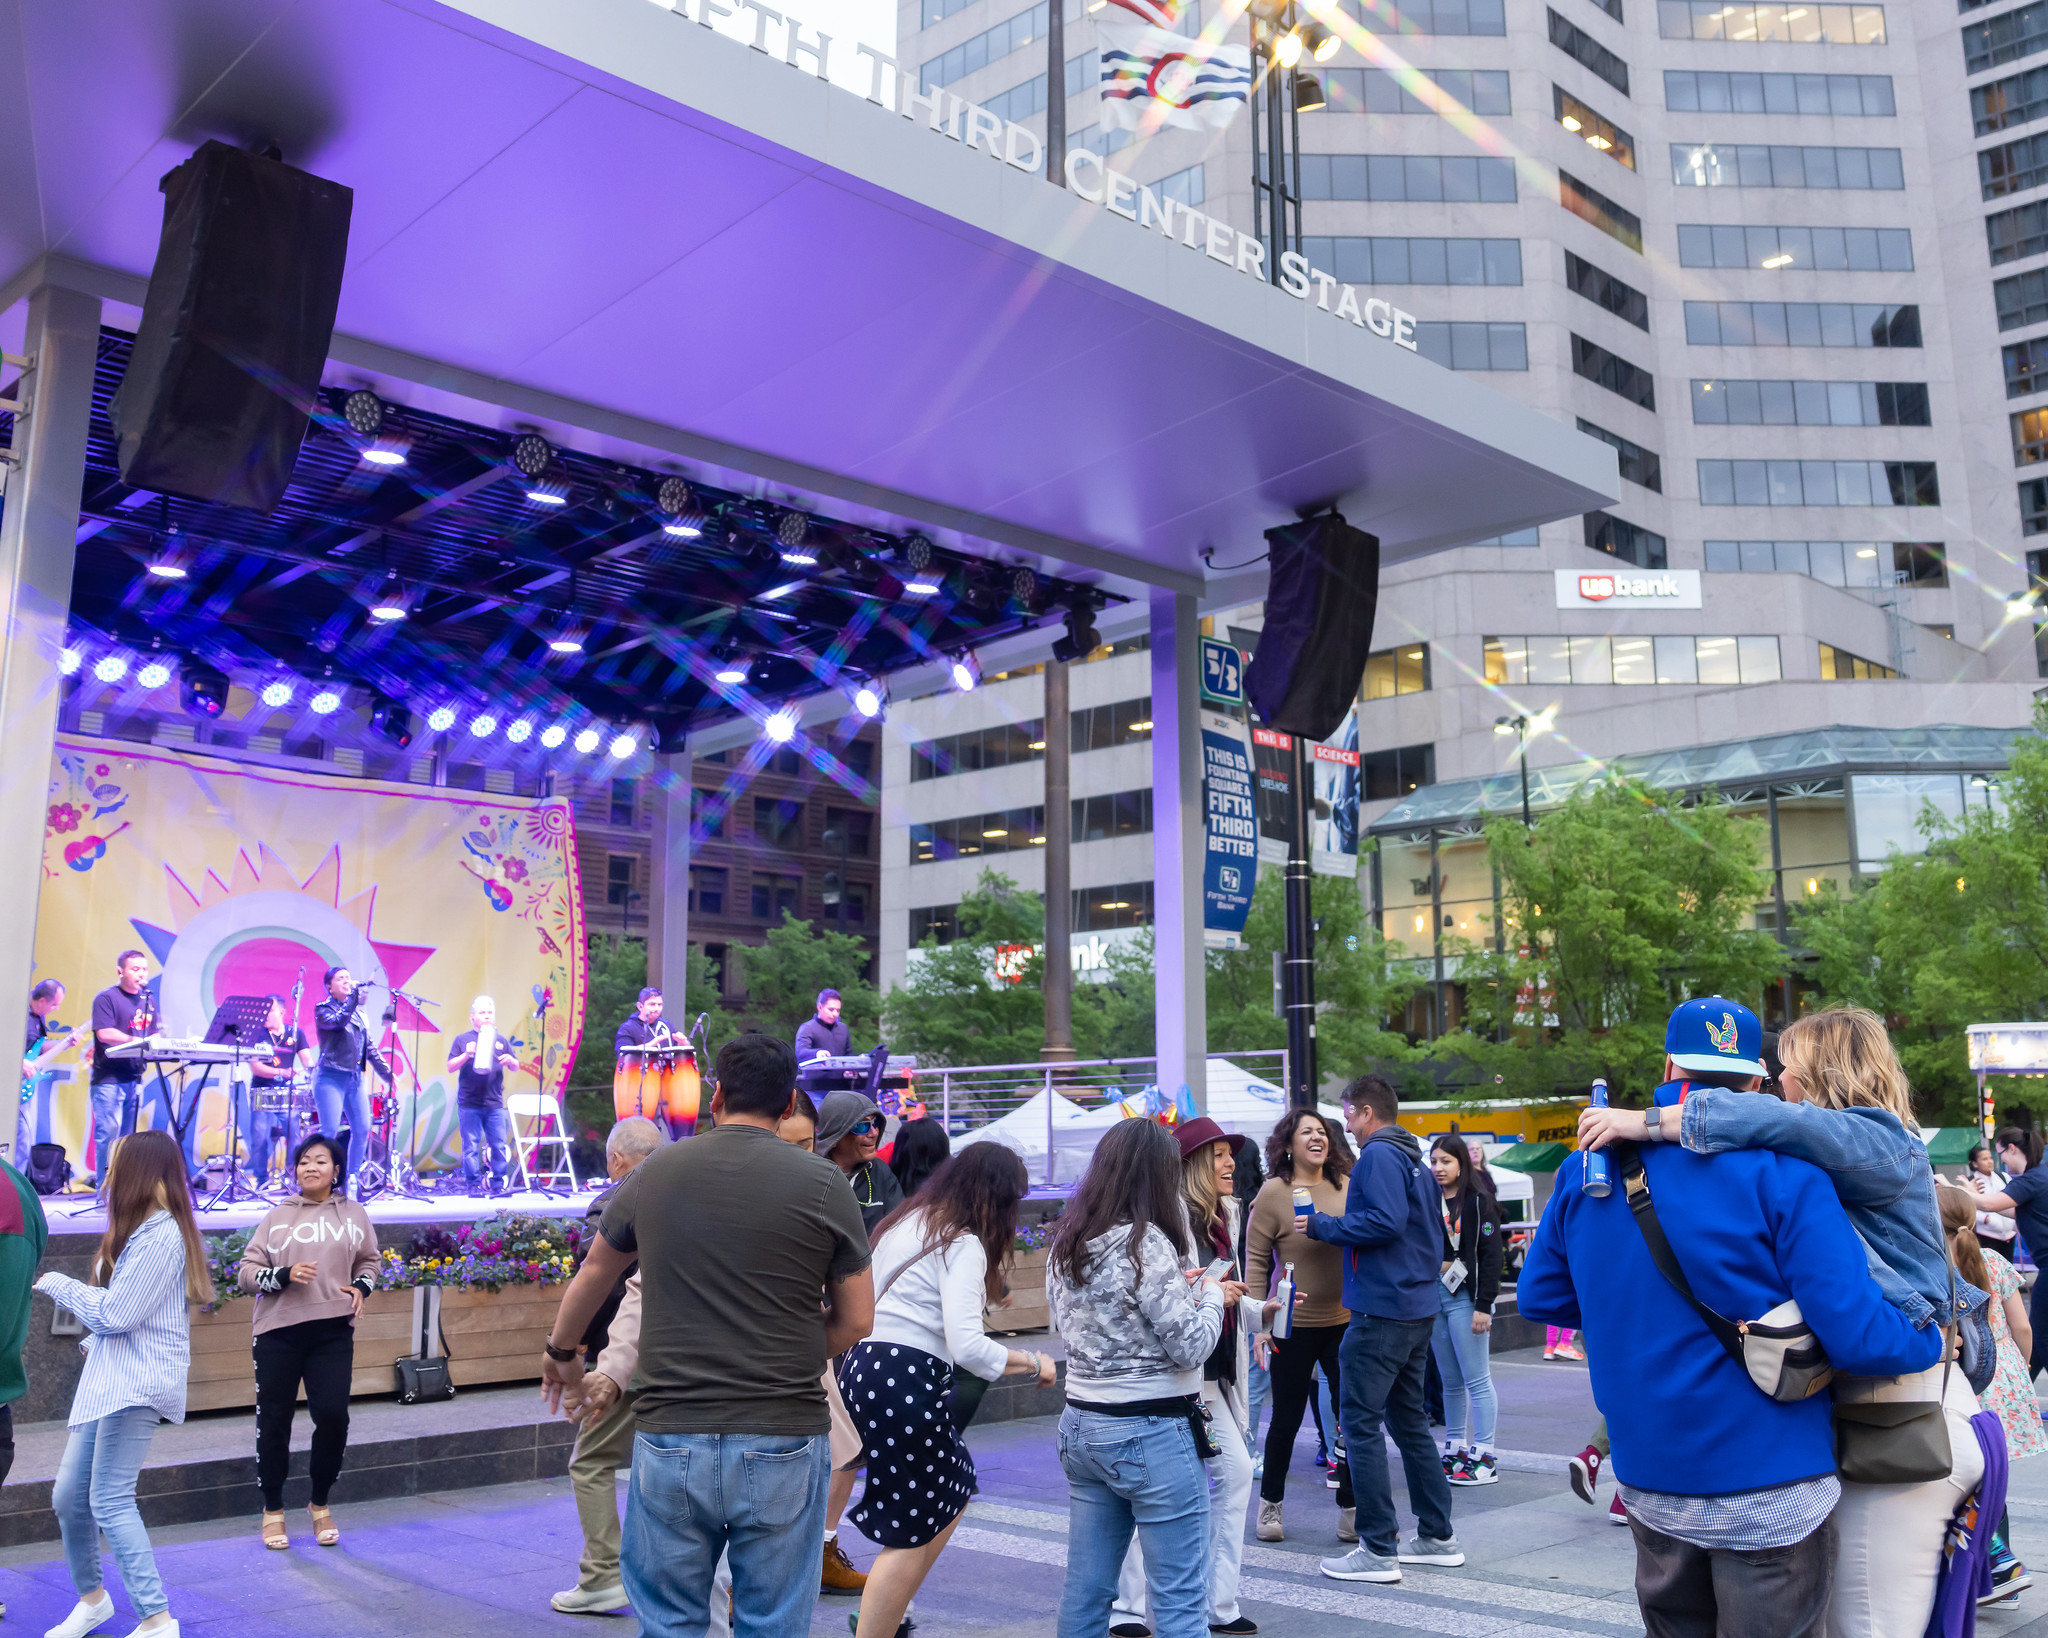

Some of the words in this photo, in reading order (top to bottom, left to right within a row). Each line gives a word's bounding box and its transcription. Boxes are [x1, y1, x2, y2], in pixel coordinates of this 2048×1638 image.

[857, 42, 1042, 173] THIRD
[1064, 148, 1266, 282] CENTER
[1280, 251, 1417, 352] STAGE
[1206, 746, 1234, 767] THIS
[1235, 754, 1247, 771] IS
[1207, 763, 1250, 784] FOUNTAIN
[1208, 777, 1244, 795] SQUARE
[1244, 785, 1251, 797] A
[1208, 790, 1252, 818] FIFTH
[1209, 813, 1254, 839] THIRD
[1208, 835, 1254, 857] BETTER
[1537, 1124, 1580, 1143] PENSK
